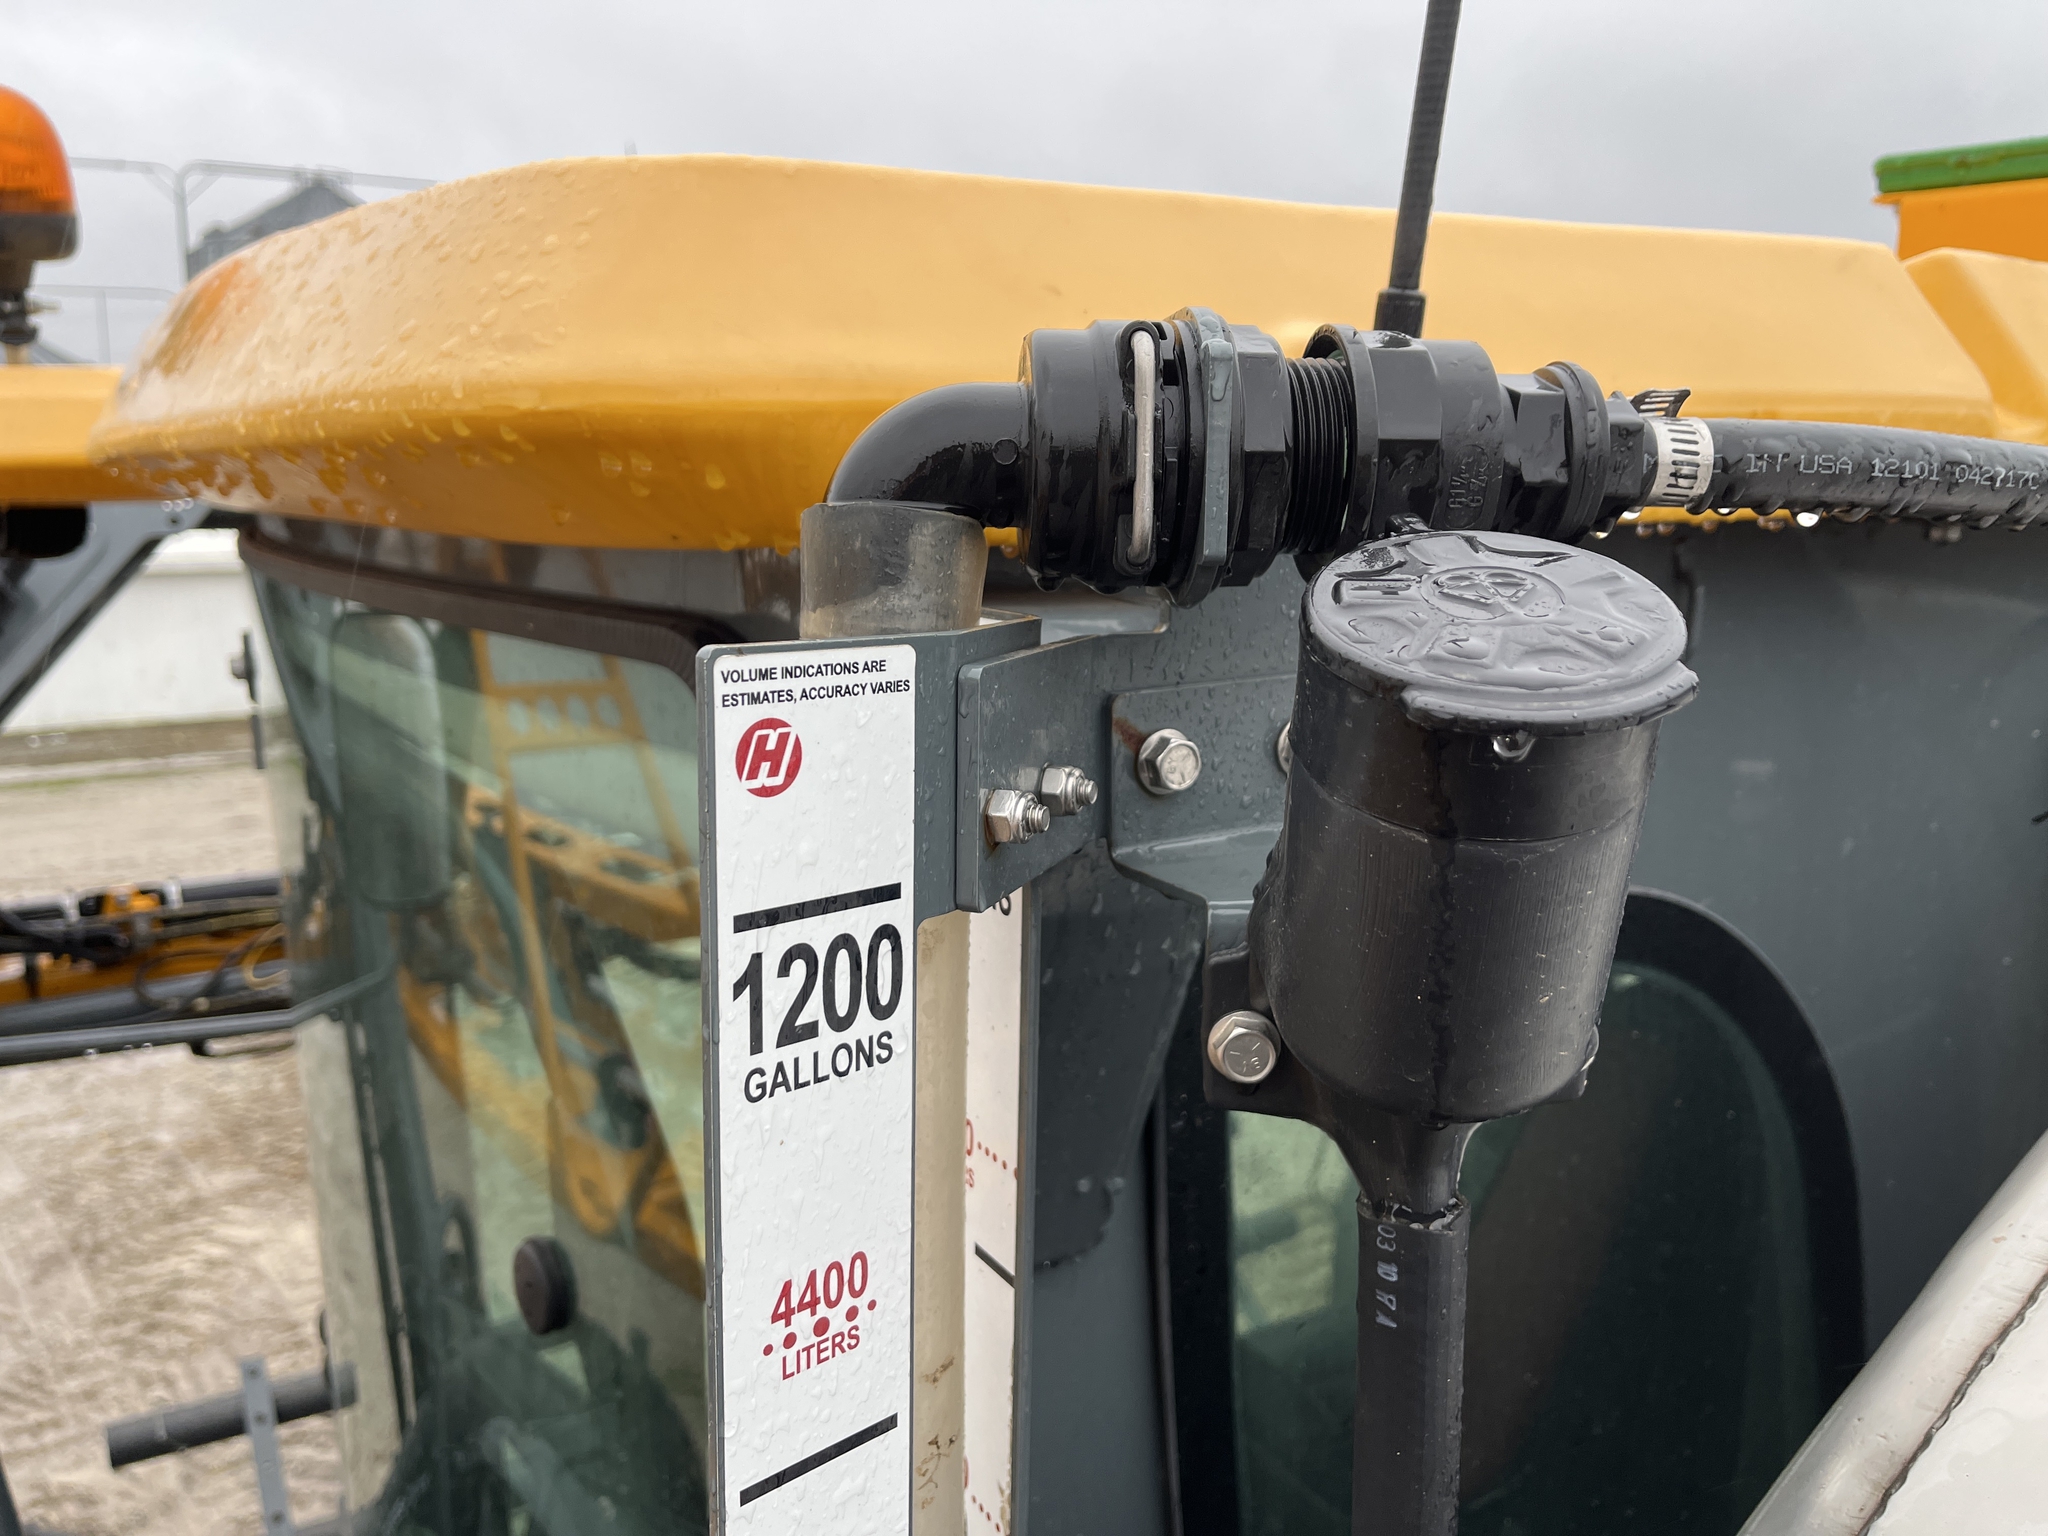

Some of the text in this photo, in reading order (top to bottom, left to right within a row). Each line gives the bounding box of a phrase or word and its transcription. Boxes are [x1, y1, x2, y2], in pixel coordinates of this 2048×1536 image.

[1800, 453, 1853, 475] USA
[1871, 457, 1940, 481] 12101
[721, 660, 887, 684] VOLUME INDICATIONS ARE
[722, 679, 911, 708] ESTIMATES, ACCURACY VARIES
[733, 923, 903, 1056] 1200
[744, 1031, 894, 1103] GALLONS
[770, 1251, 869, 1328] 4400
[781, 1325, 860, 1381] LITERS
